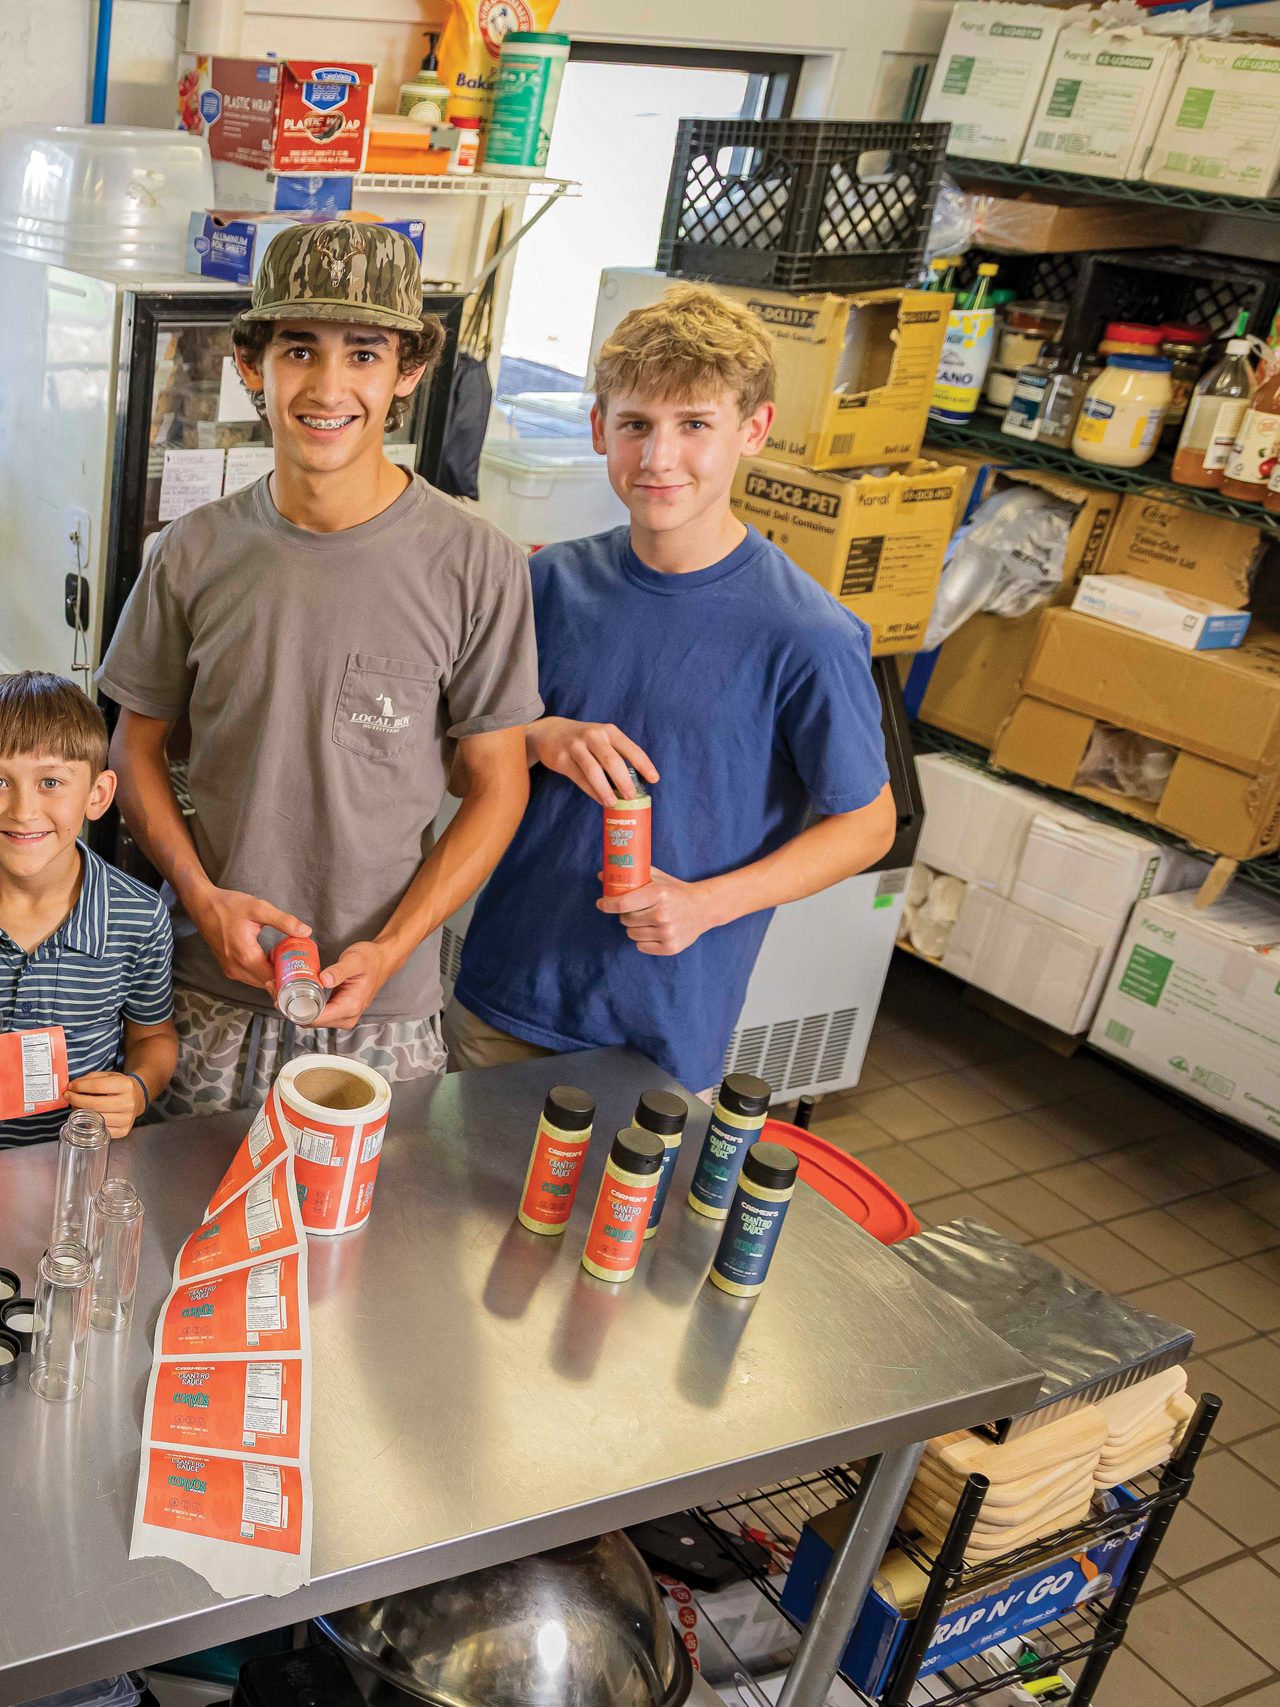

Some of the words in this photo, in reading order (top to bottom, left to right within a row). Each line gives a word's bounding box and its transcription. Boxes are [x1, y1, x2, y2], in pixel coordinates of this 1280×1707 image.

[212, 231, 248, 247] ALUMINUM
[748, 476, 839, 516] FP-DC8-PET
[745, 502, 770, 516] Round
[772, 509, 790, 522] Deli
[792, 514, 836, 535] Container
[351, 713, 391, 727] LOCAL
[394, 715, 411, 727] BOY
[547, 1147, 583, 1158] CARMEN'S
[610, 1189, 648, 1203] CARMEN'S
[611, 1201, 642, 1215] CILANTRO
[741, 1201, 779, 1217] CARMEN'S
[613, 1211, 634, 1223] SAUCE
[741, 1212, 773, 1230] CILANTRO
[742, 1222, 766, 1236] SAUCE
[173, 1392, 210, 1408] CORVOS
[168, 1475, 207, 1492] CORVOS
[986, 1590, 1025, 1623] N'
